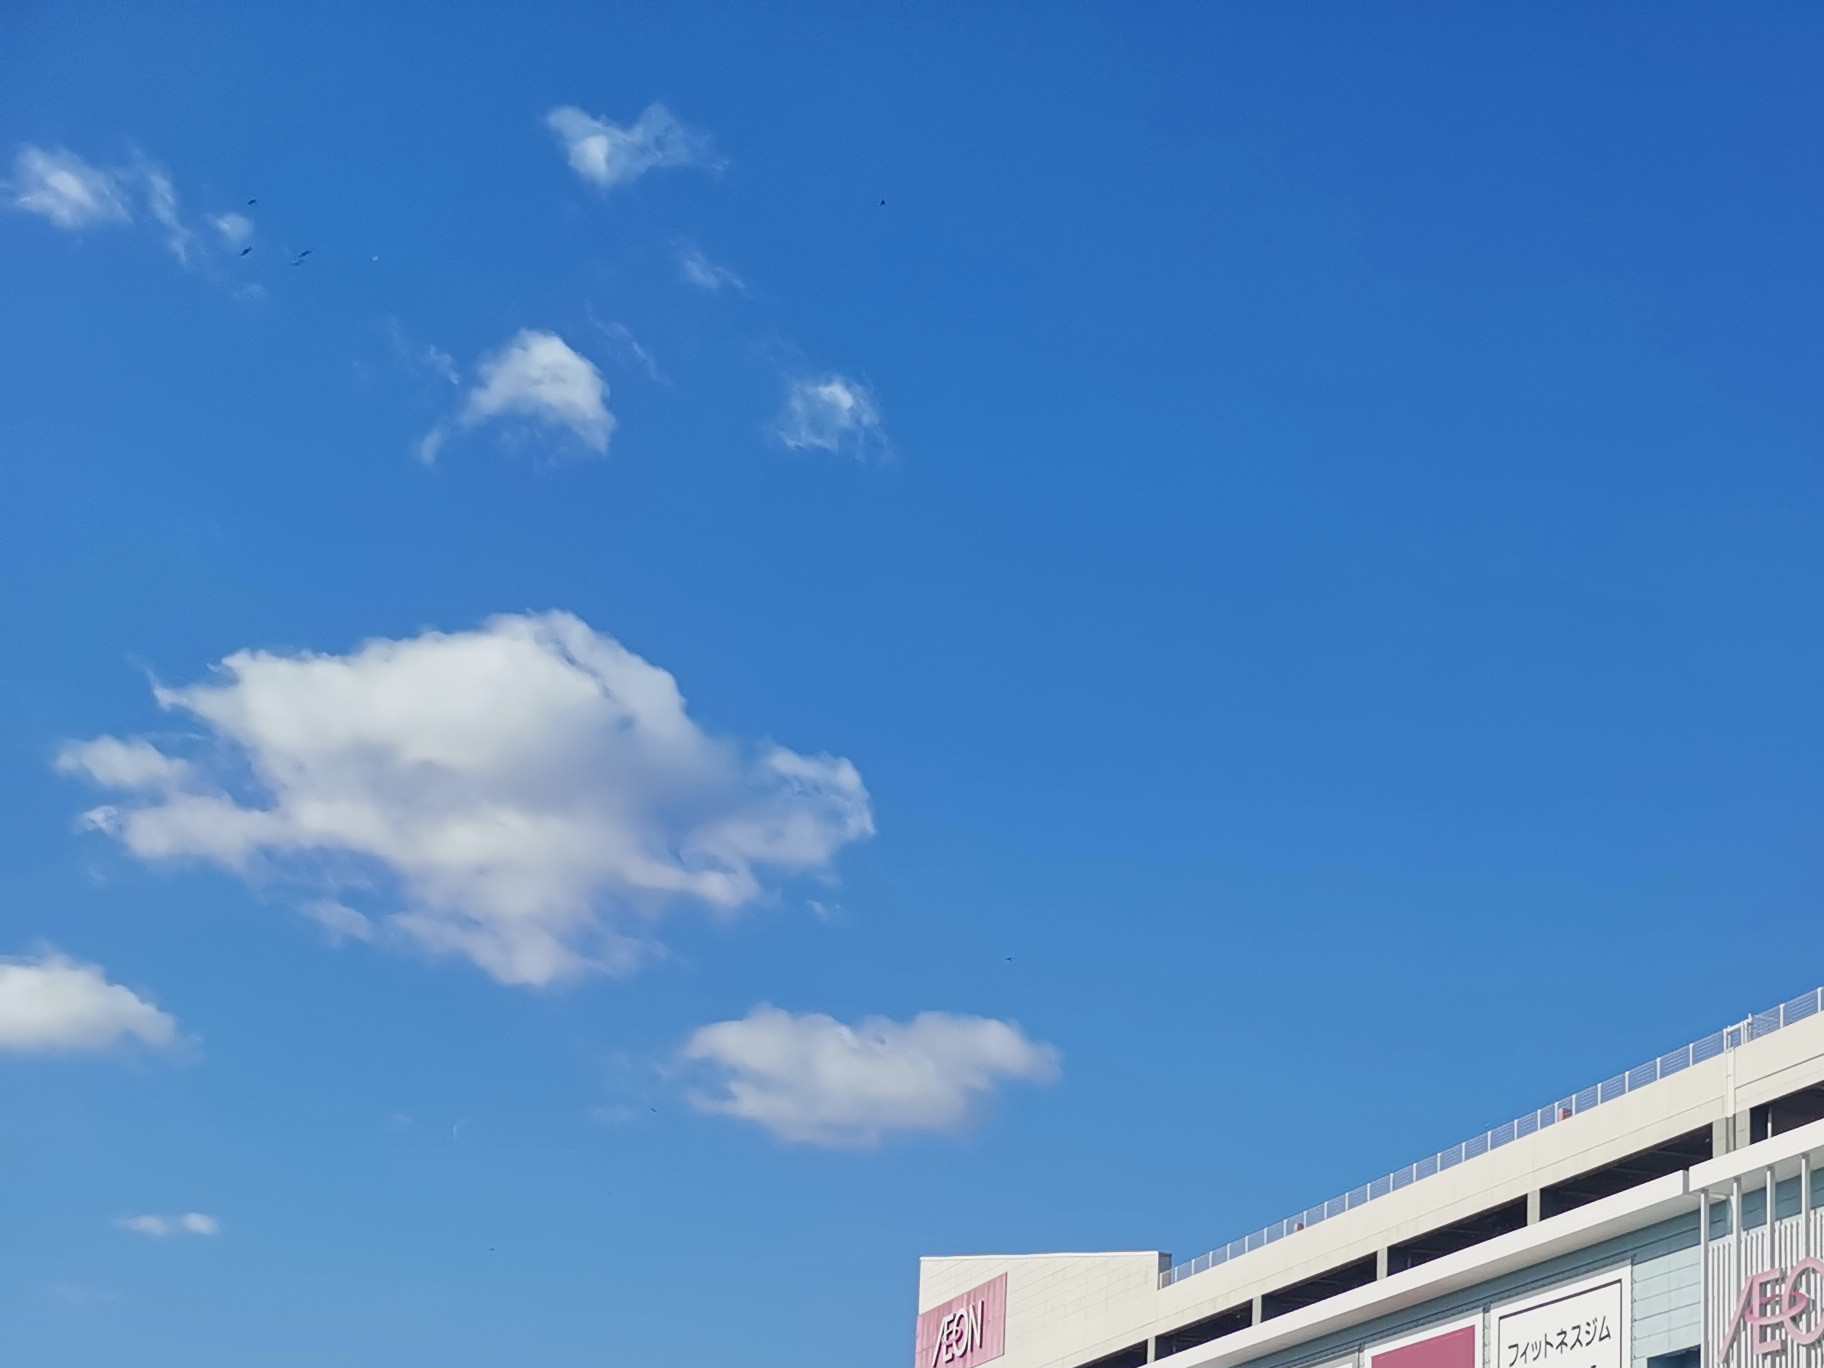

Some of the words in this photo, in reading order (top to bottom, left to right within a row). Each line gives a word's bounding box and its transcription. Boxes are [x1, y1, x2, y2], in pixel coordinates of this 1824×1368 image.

[1507, 1315, 1612, 1368] フィットネスジム
